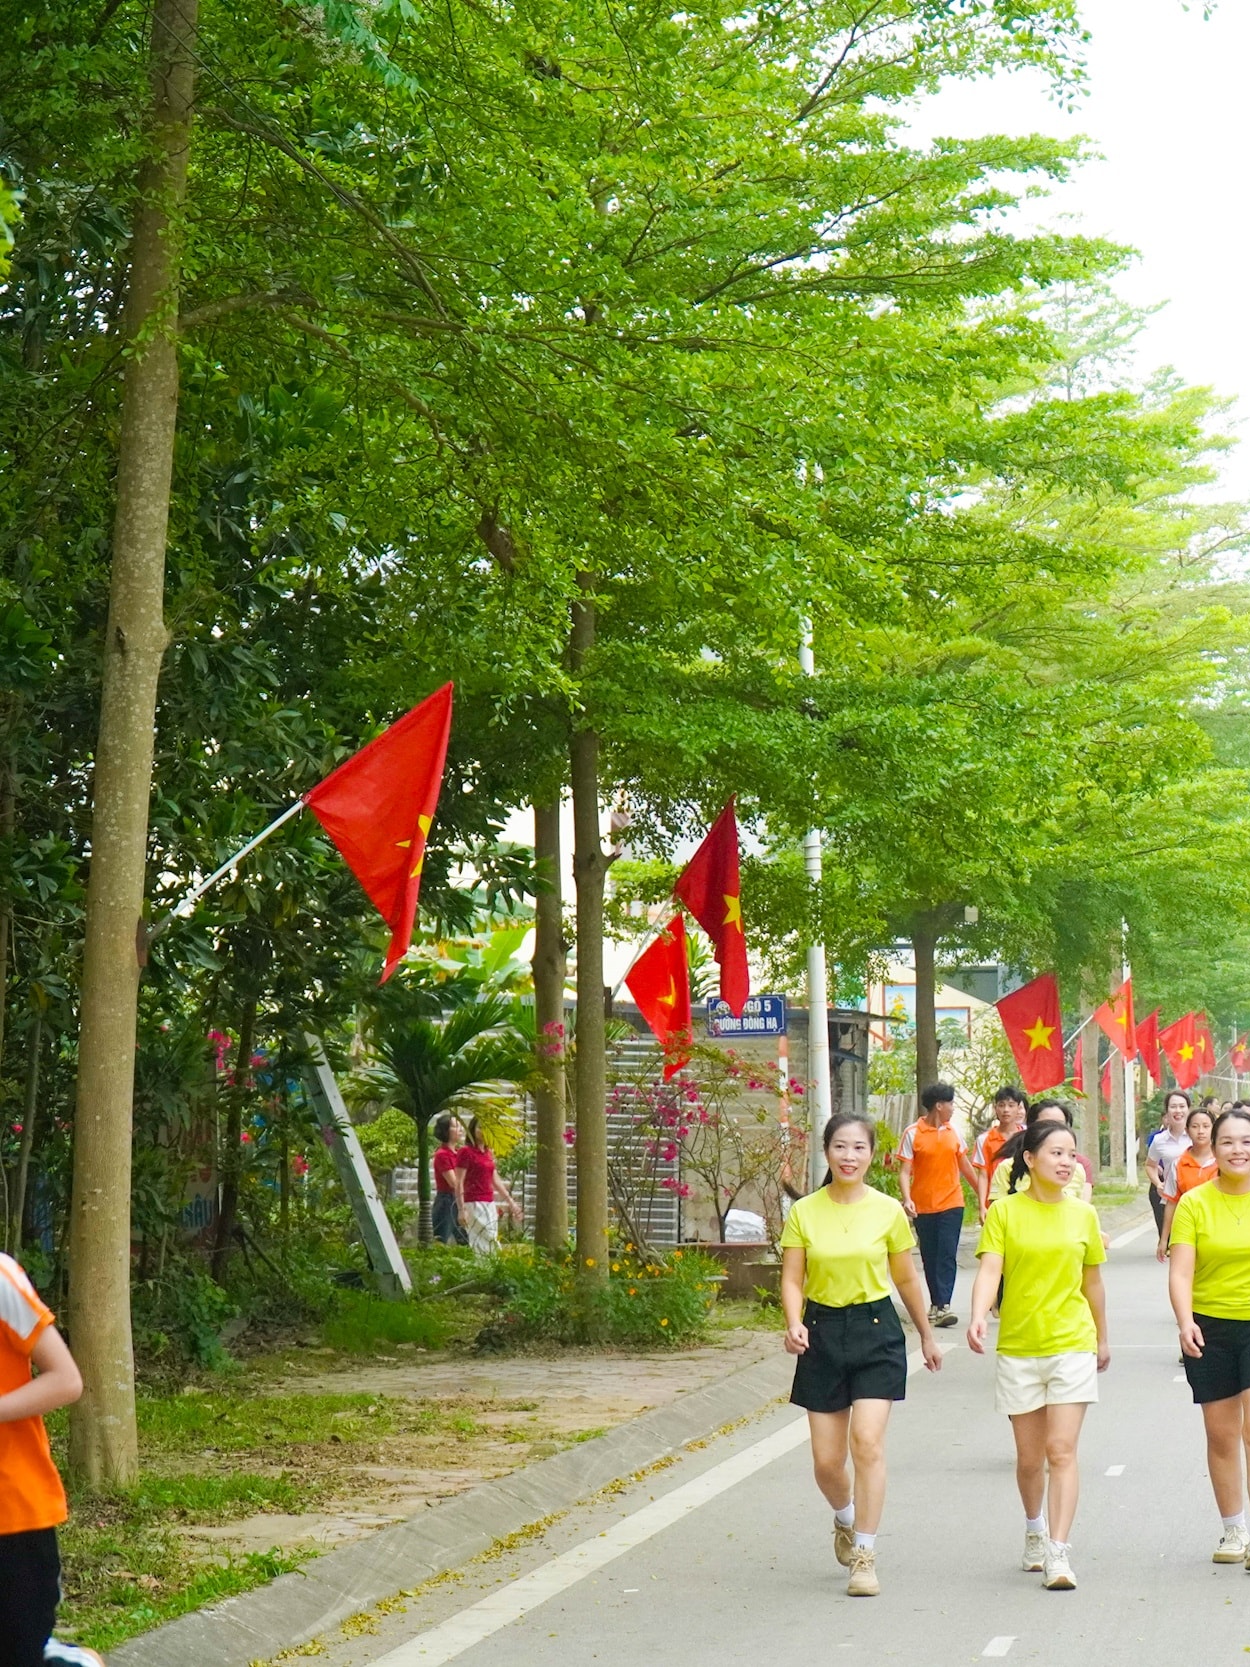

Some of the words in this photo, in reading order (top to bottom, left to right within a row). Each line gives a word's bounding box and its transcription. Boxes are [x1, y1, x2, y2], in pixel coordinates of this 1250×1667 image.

[743, 998, 761, 1013] GÕ
[764, 999, 771, 1012] 5
[766, 1016, 778, 1032] HẠ
